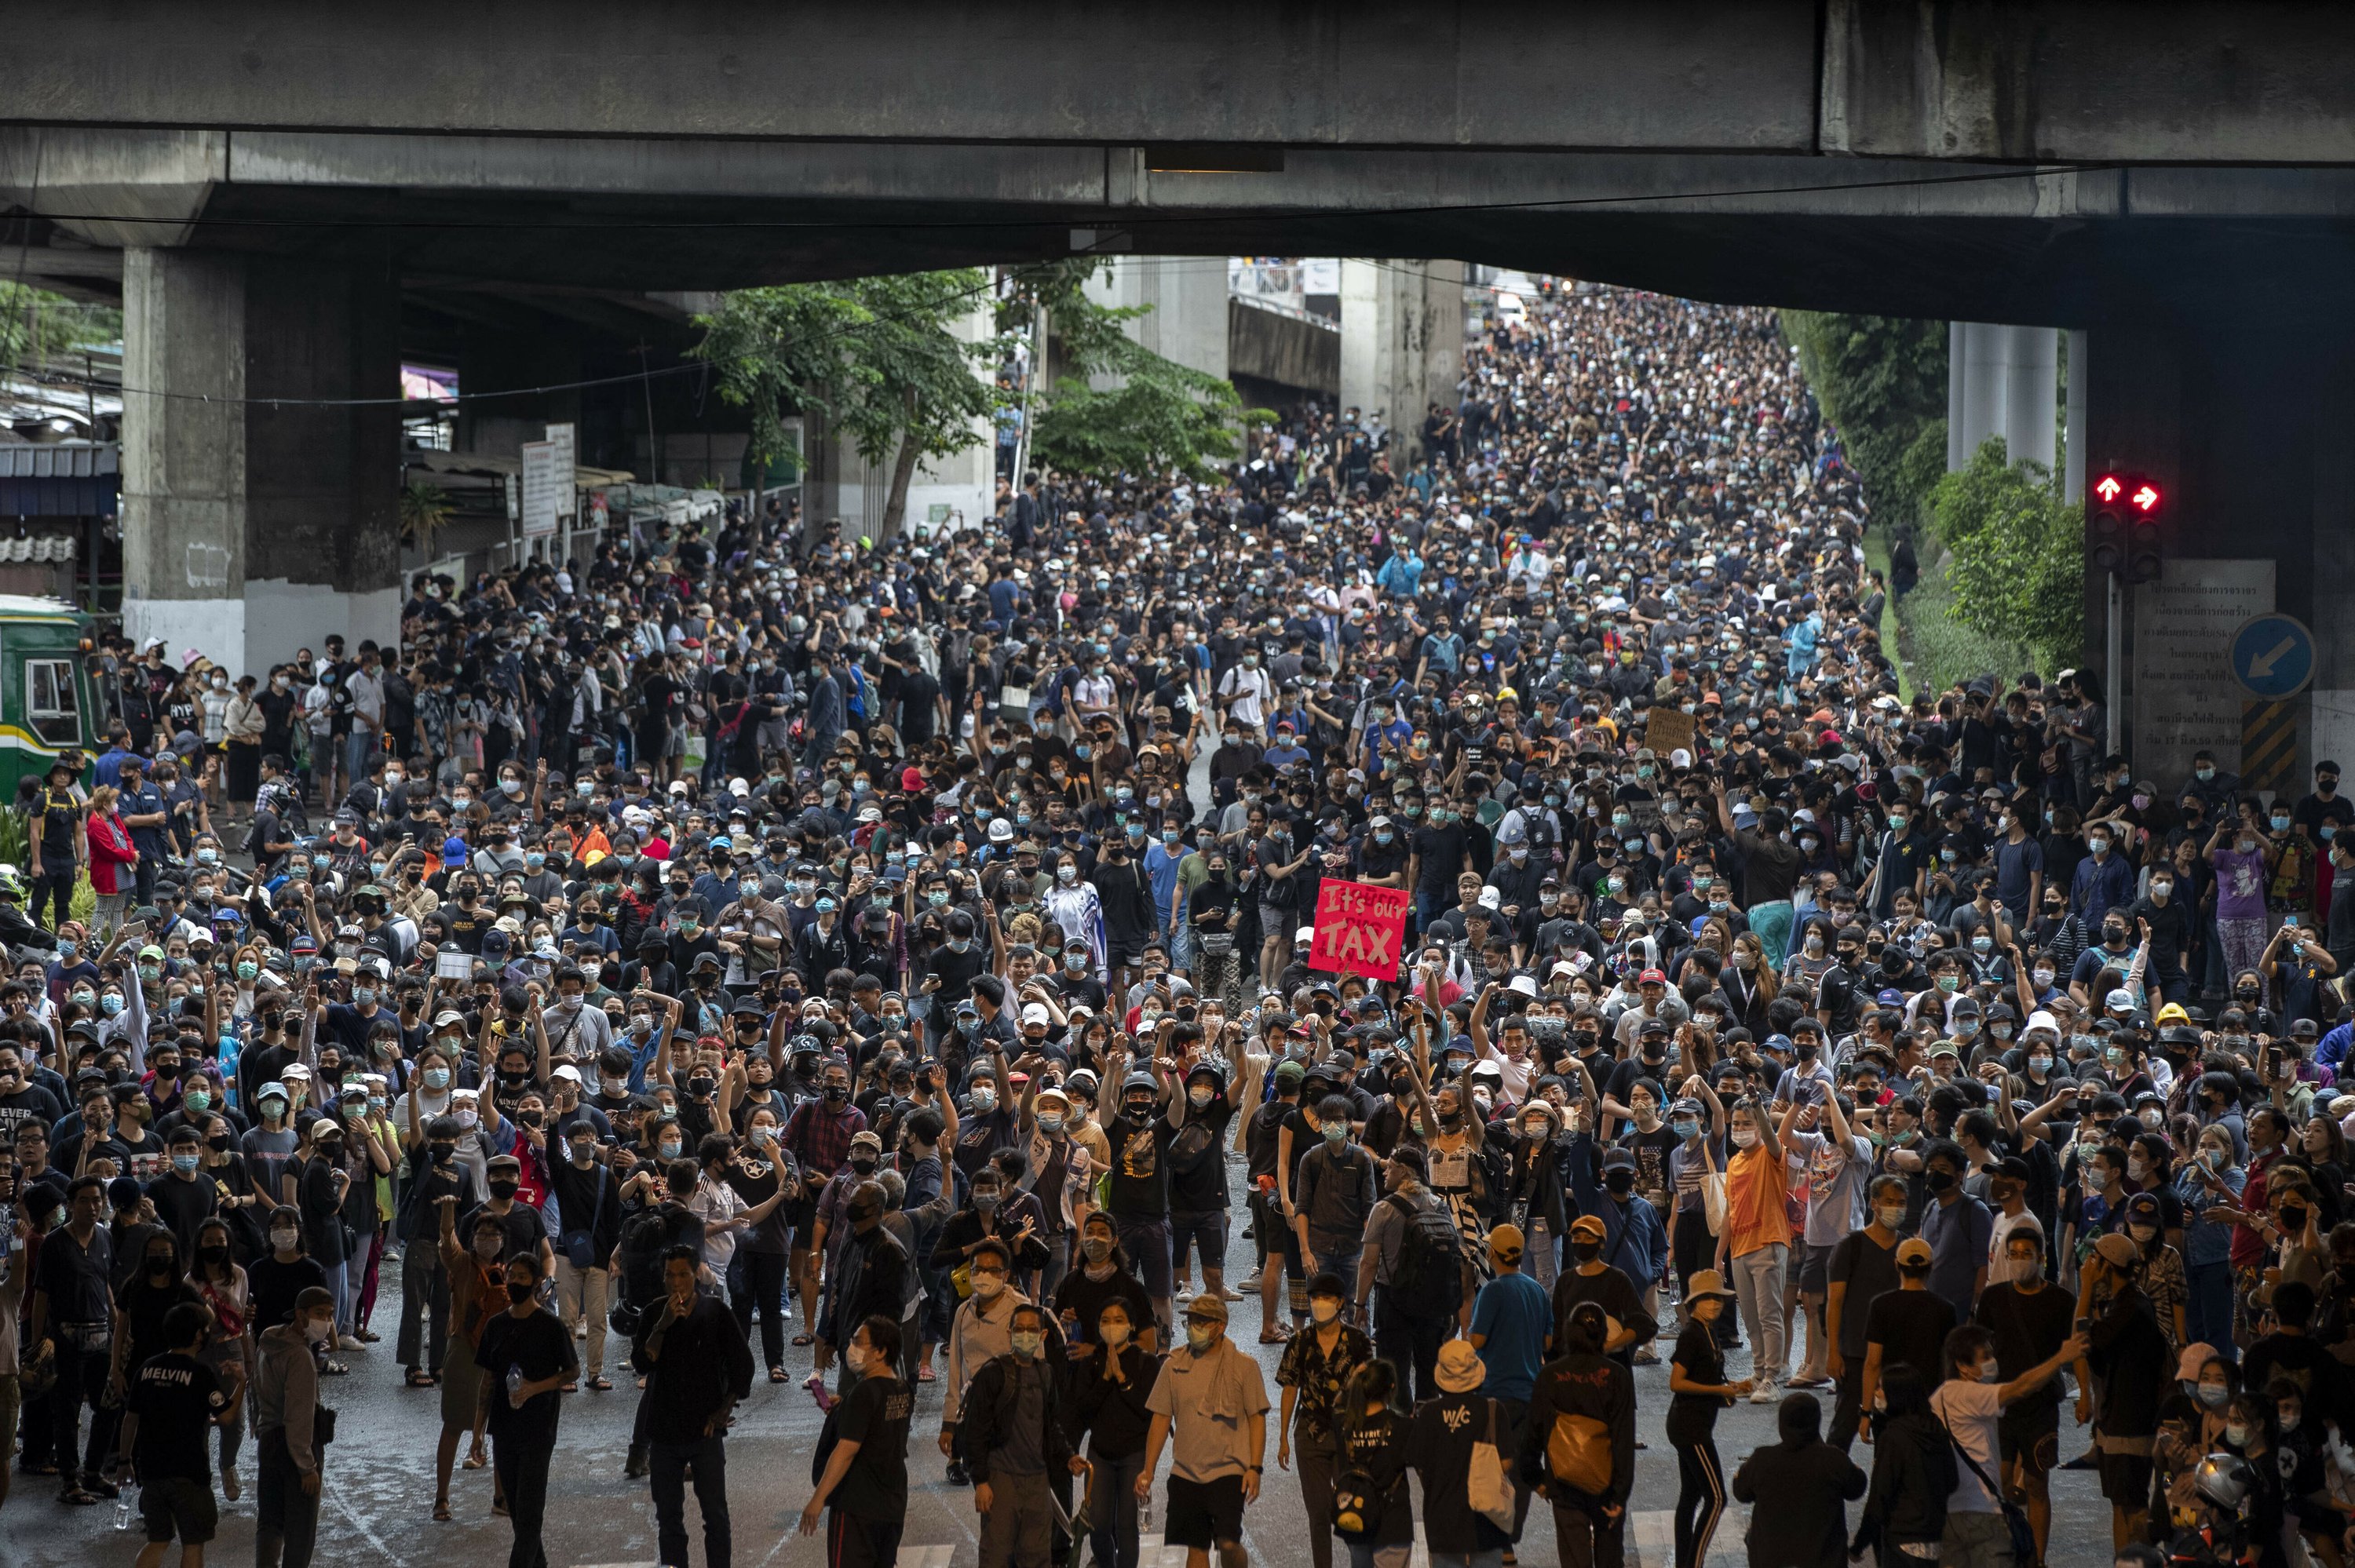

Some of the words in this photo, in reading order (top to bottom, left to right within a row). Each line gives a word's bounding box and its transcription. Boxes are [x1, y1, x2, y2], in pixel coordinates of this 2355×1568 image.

[2167, 736, 2175, 745] 17
[1324, 885, 1365, 914] It's
[1374, 902, 1406, 920] our
[1320, 920, 1393, 965] TAX
[141, 1367, 192, 1387] MELVIN
